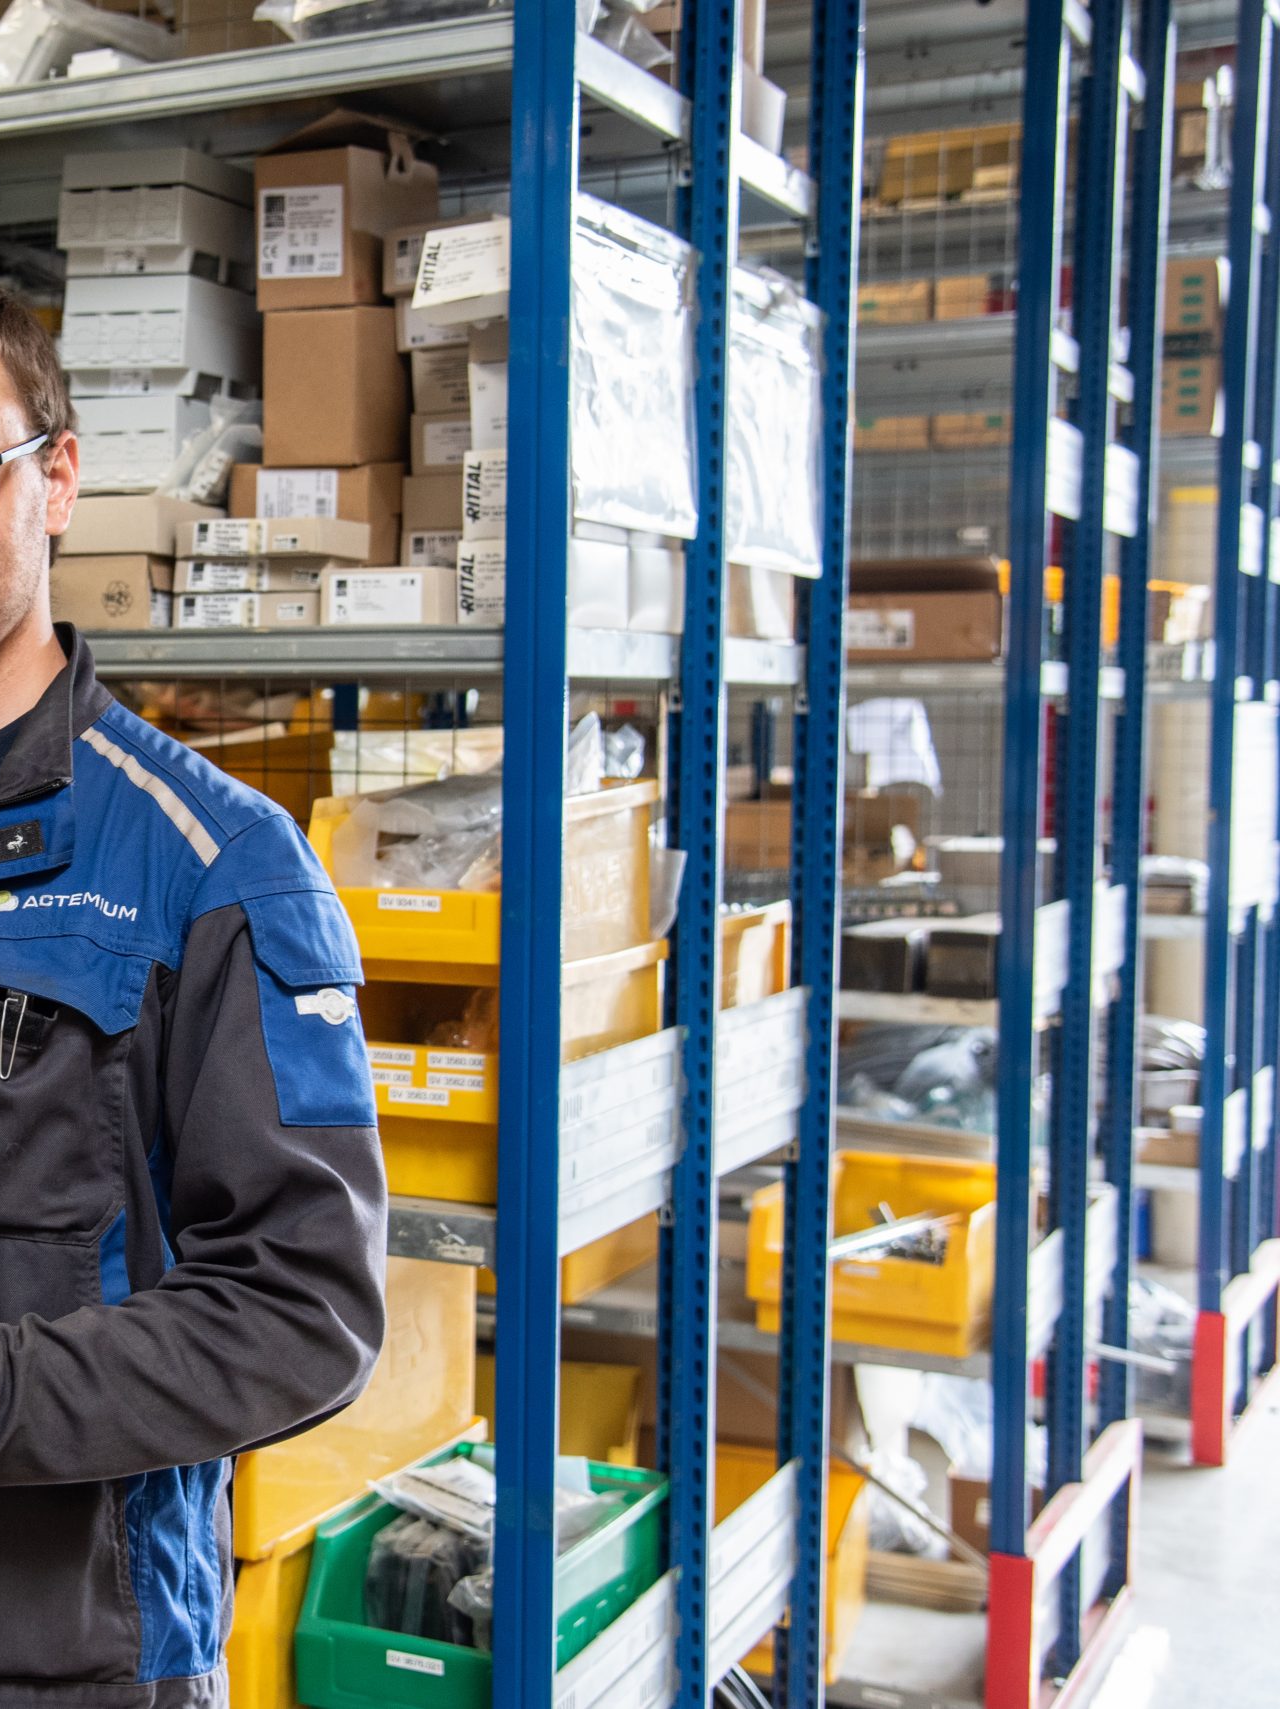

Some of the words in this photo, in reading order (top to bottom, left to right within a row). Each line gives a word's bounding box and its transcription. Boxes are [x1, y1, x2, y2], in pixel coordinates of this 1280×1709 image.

[420, 241, 442, 295] RITTAL
[466, 460, 482, 523] RITTAL
[460, 553, 475, 615] RITTAL
[22, 892, 138, 922] ACTEMIUM
